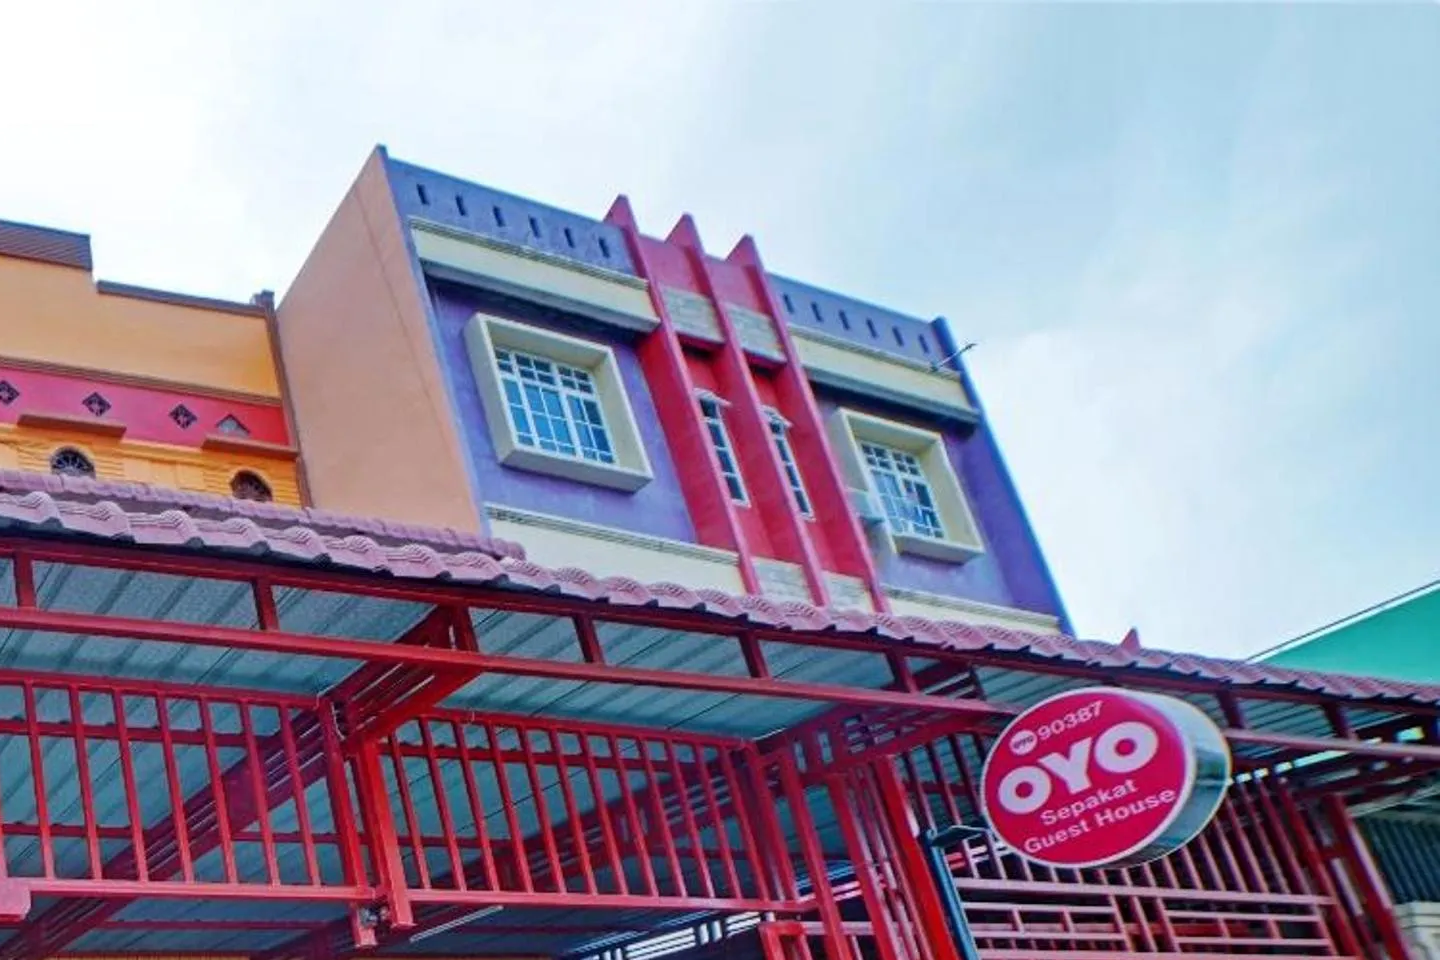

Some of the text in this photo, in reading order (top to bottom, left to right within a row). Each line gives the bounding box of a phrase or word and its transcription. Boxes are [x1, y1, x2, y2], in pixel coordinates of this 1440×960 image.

[1037, 699, 1103, 741] 90387
[997, 720, 1159, 815] OYO
[1024, 789, 1177, 853] Guest House
[1040, 779, 1138, 826] Sepakat
